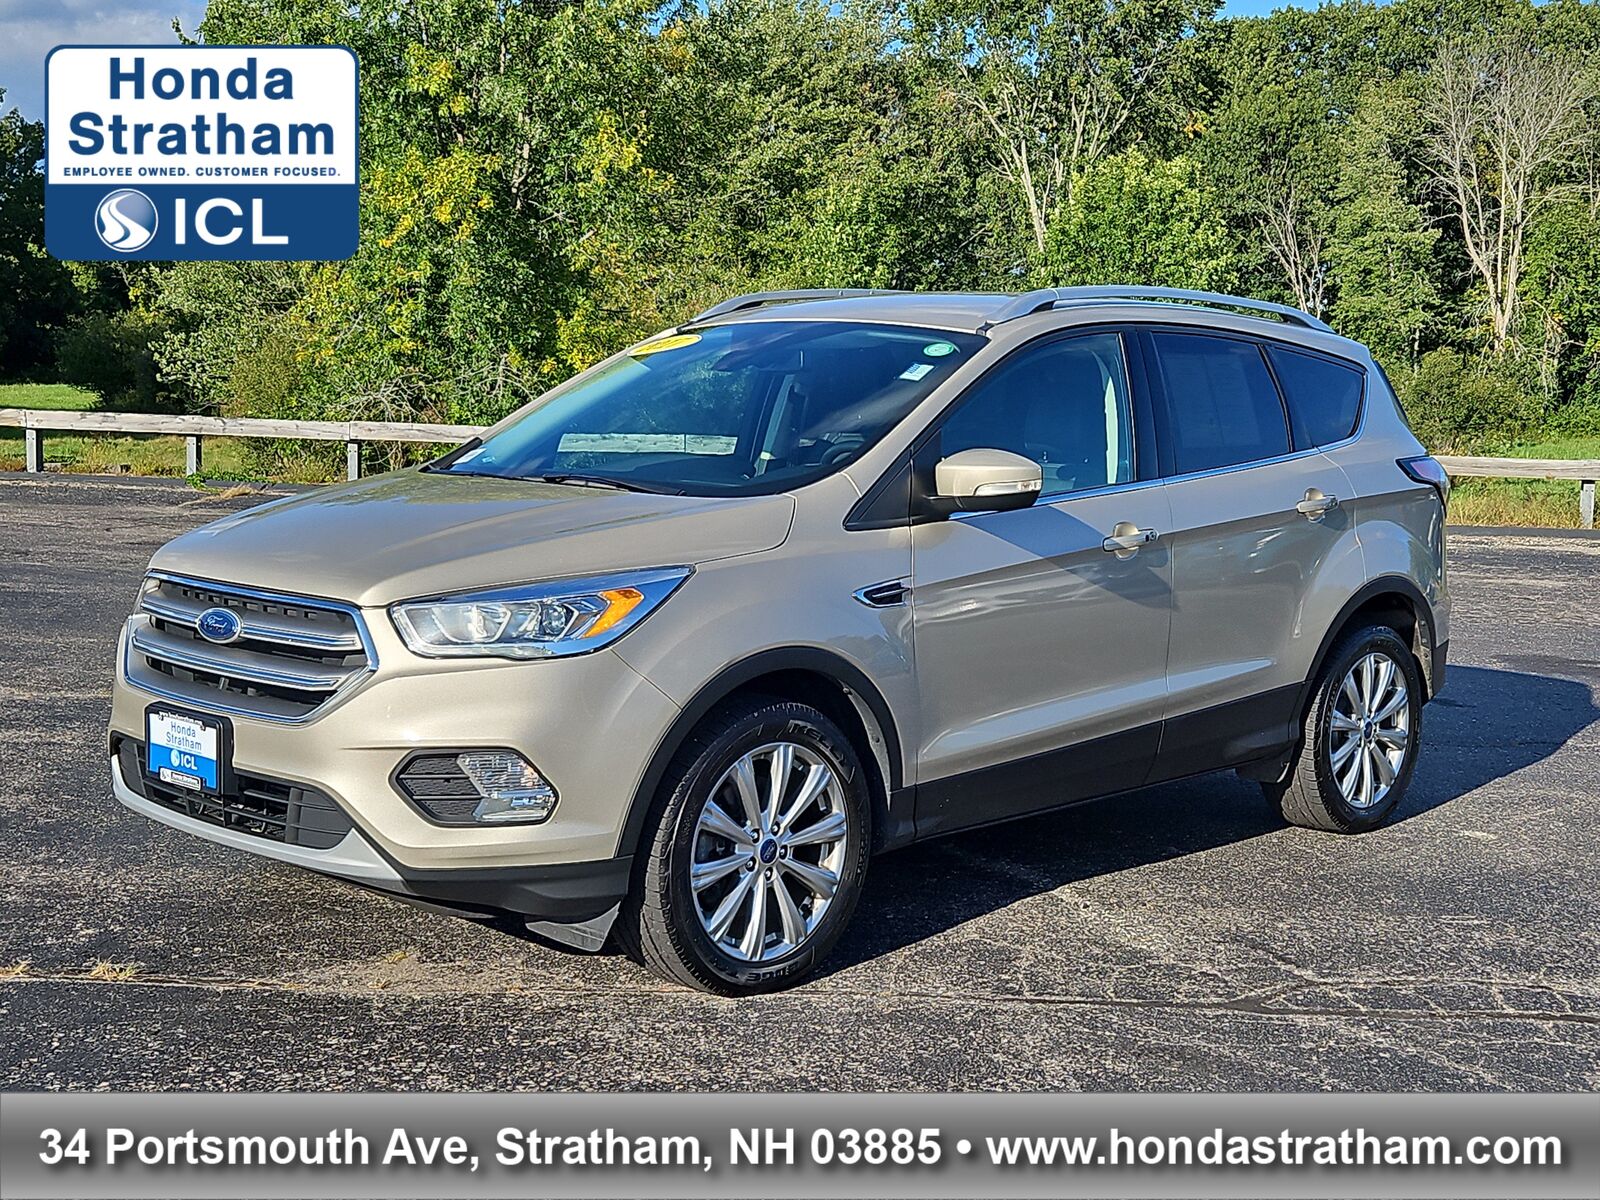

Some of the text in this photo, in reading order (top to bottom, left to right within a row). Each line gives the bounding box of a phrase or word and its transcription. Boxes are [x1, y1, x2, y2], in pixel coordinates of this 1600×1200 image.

[170, 721, 196, 738] Honda
[166, 731, 202, 751] Stratham
[181, 754, 198, 770] ICL
